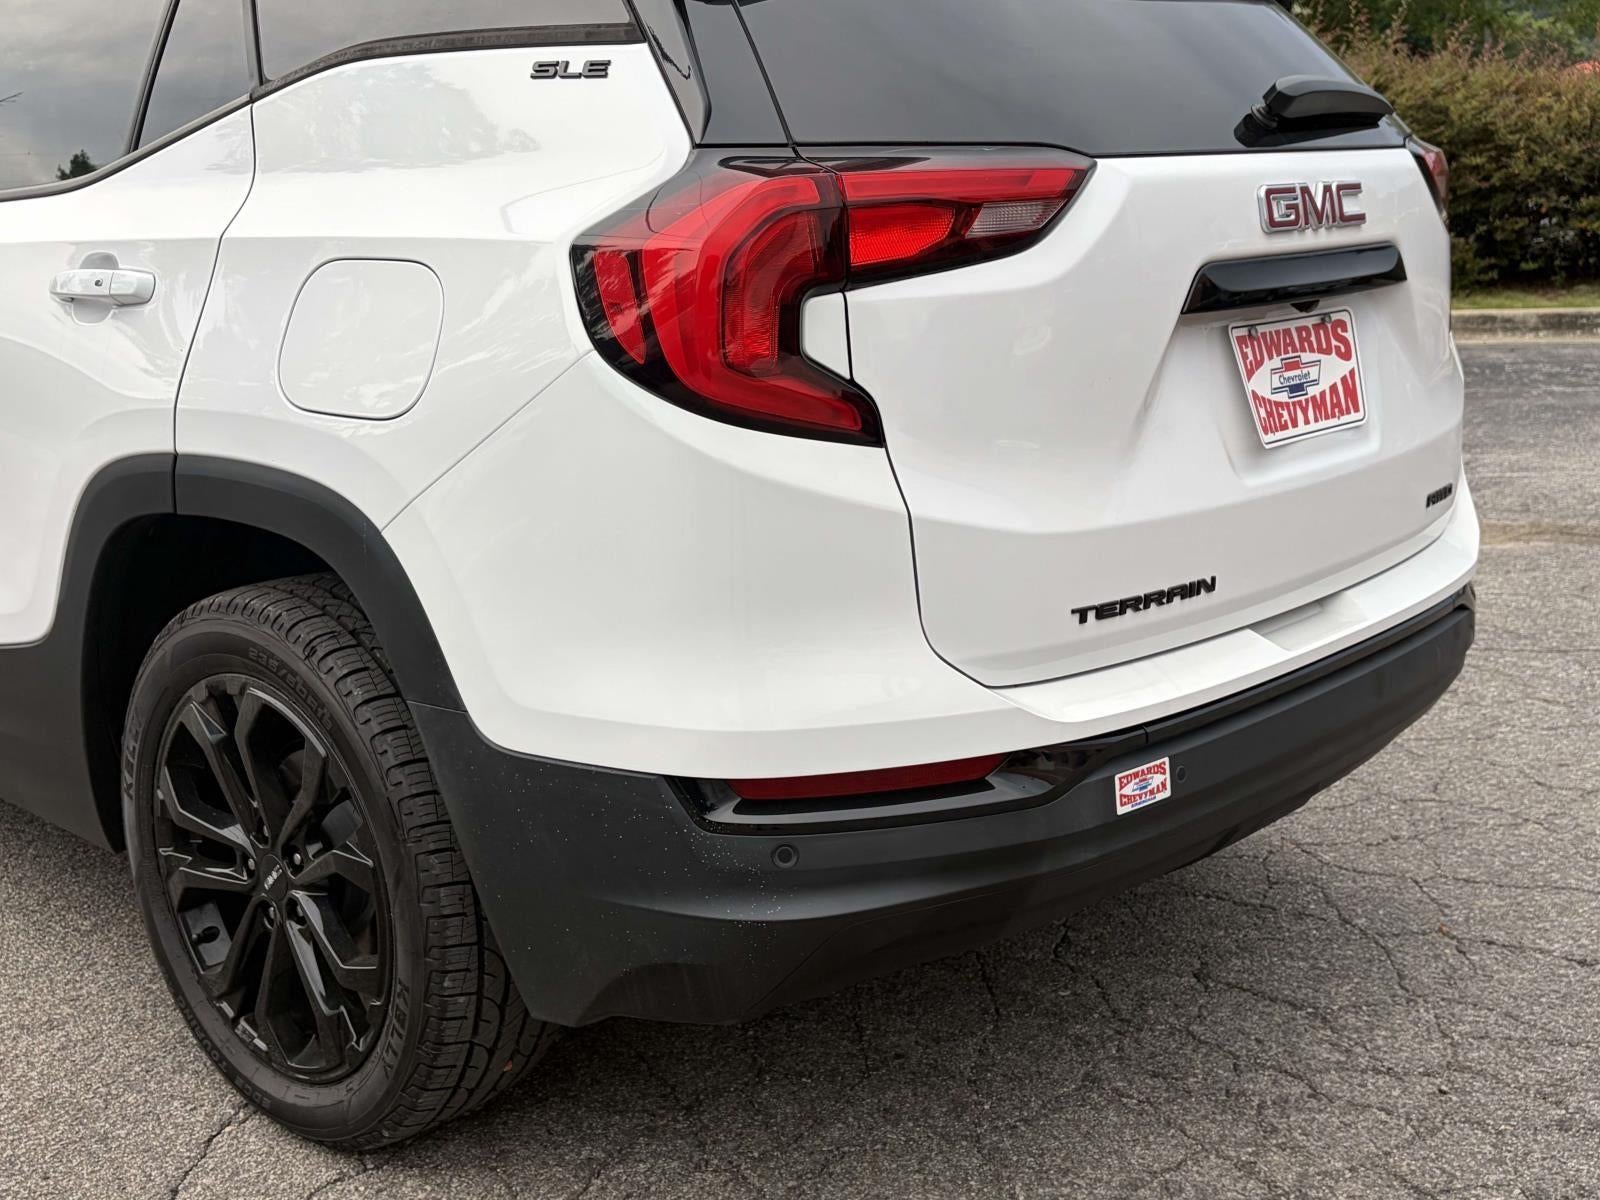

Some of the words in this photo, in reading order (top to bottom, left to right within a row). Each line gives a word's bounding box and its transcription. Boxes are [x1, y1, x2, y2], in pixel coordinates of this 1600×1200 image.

[530, 59, 611, 79] SLE
[1257, 179, 1366, 234] GMC
[1236, 318, 1353, 384] EDWARDS
[1278, 369, 1311, 385] Chevrolet
[1251, 366, 1360, 437] CHEVYMAN
[1071, 575, 1217, 625] TERRAIN
[1118, 760, 1167, 792] EDWARDS
[1119, 777, 1168, 807] CHEVYMAN
